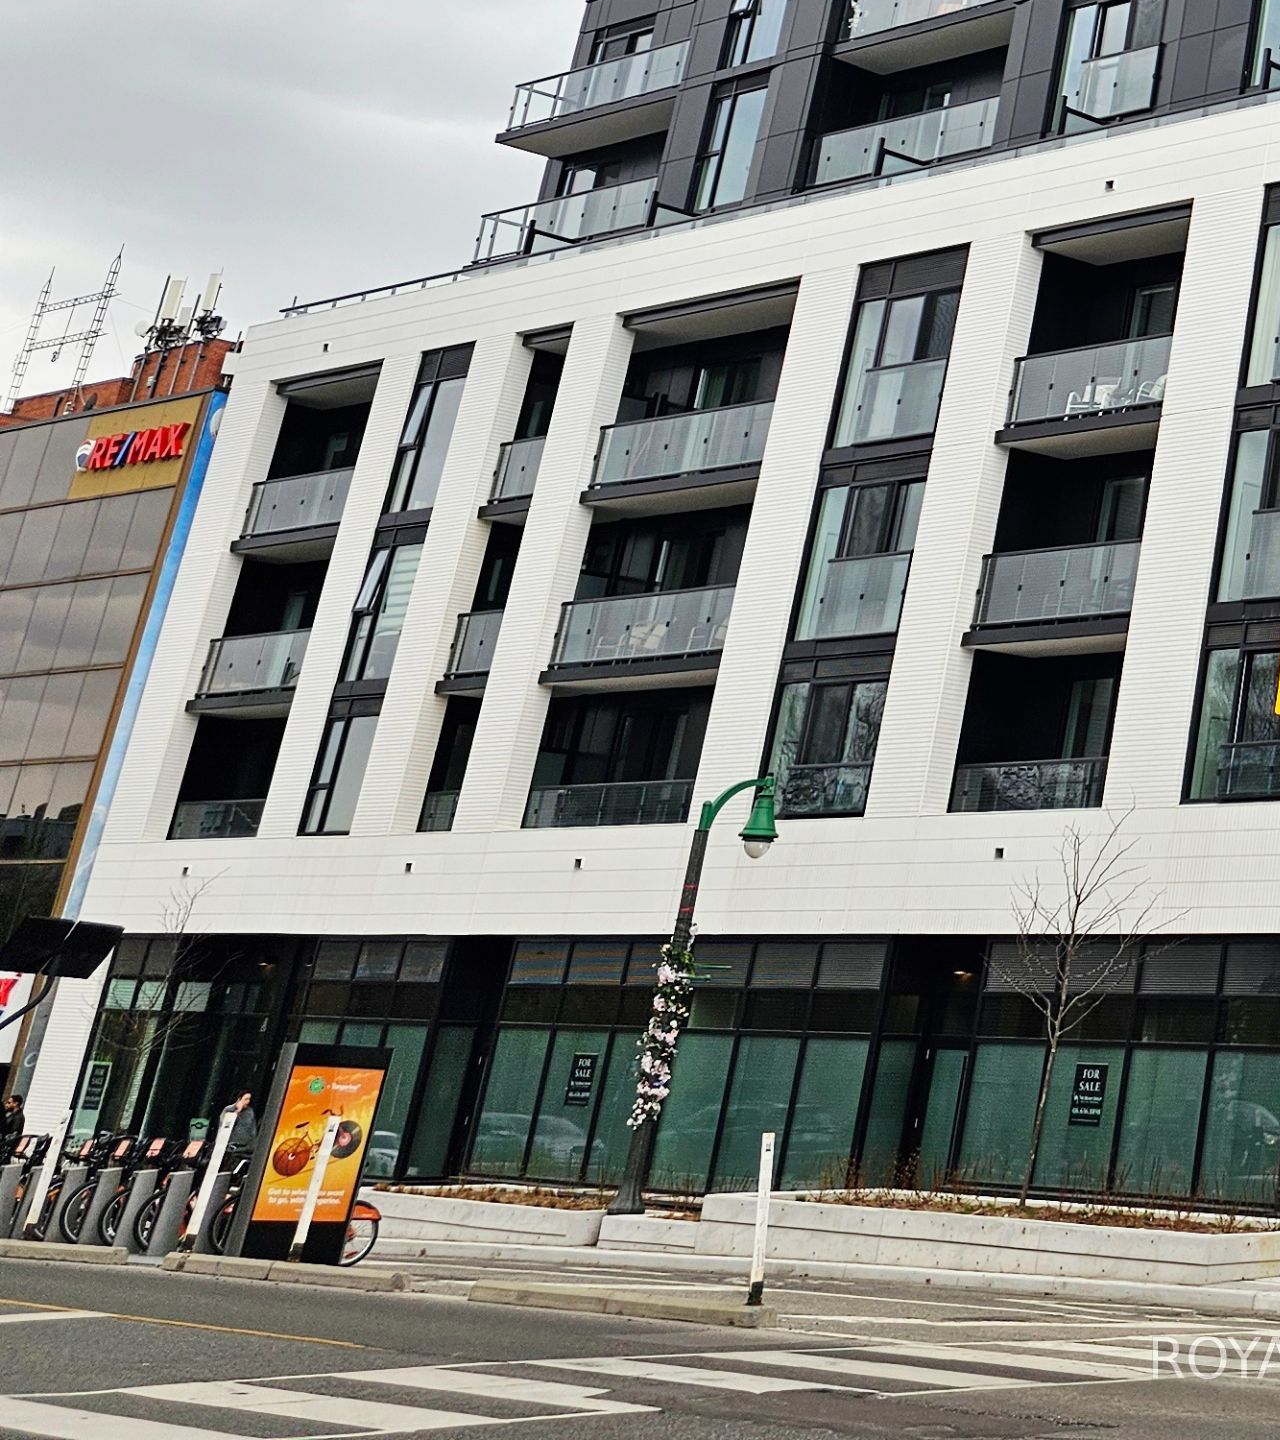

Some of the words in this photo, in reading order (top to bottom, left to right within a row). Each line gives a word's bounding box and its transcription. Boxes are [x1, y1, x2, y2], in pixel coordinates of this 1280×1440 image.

[88, 422, 191, 472] RE/MAX
[574, 1068, 592, 1078] SALE
[1082, 1068, 1100, 1079] FOR
[1078, 1081, 1101, 1091] SALE
